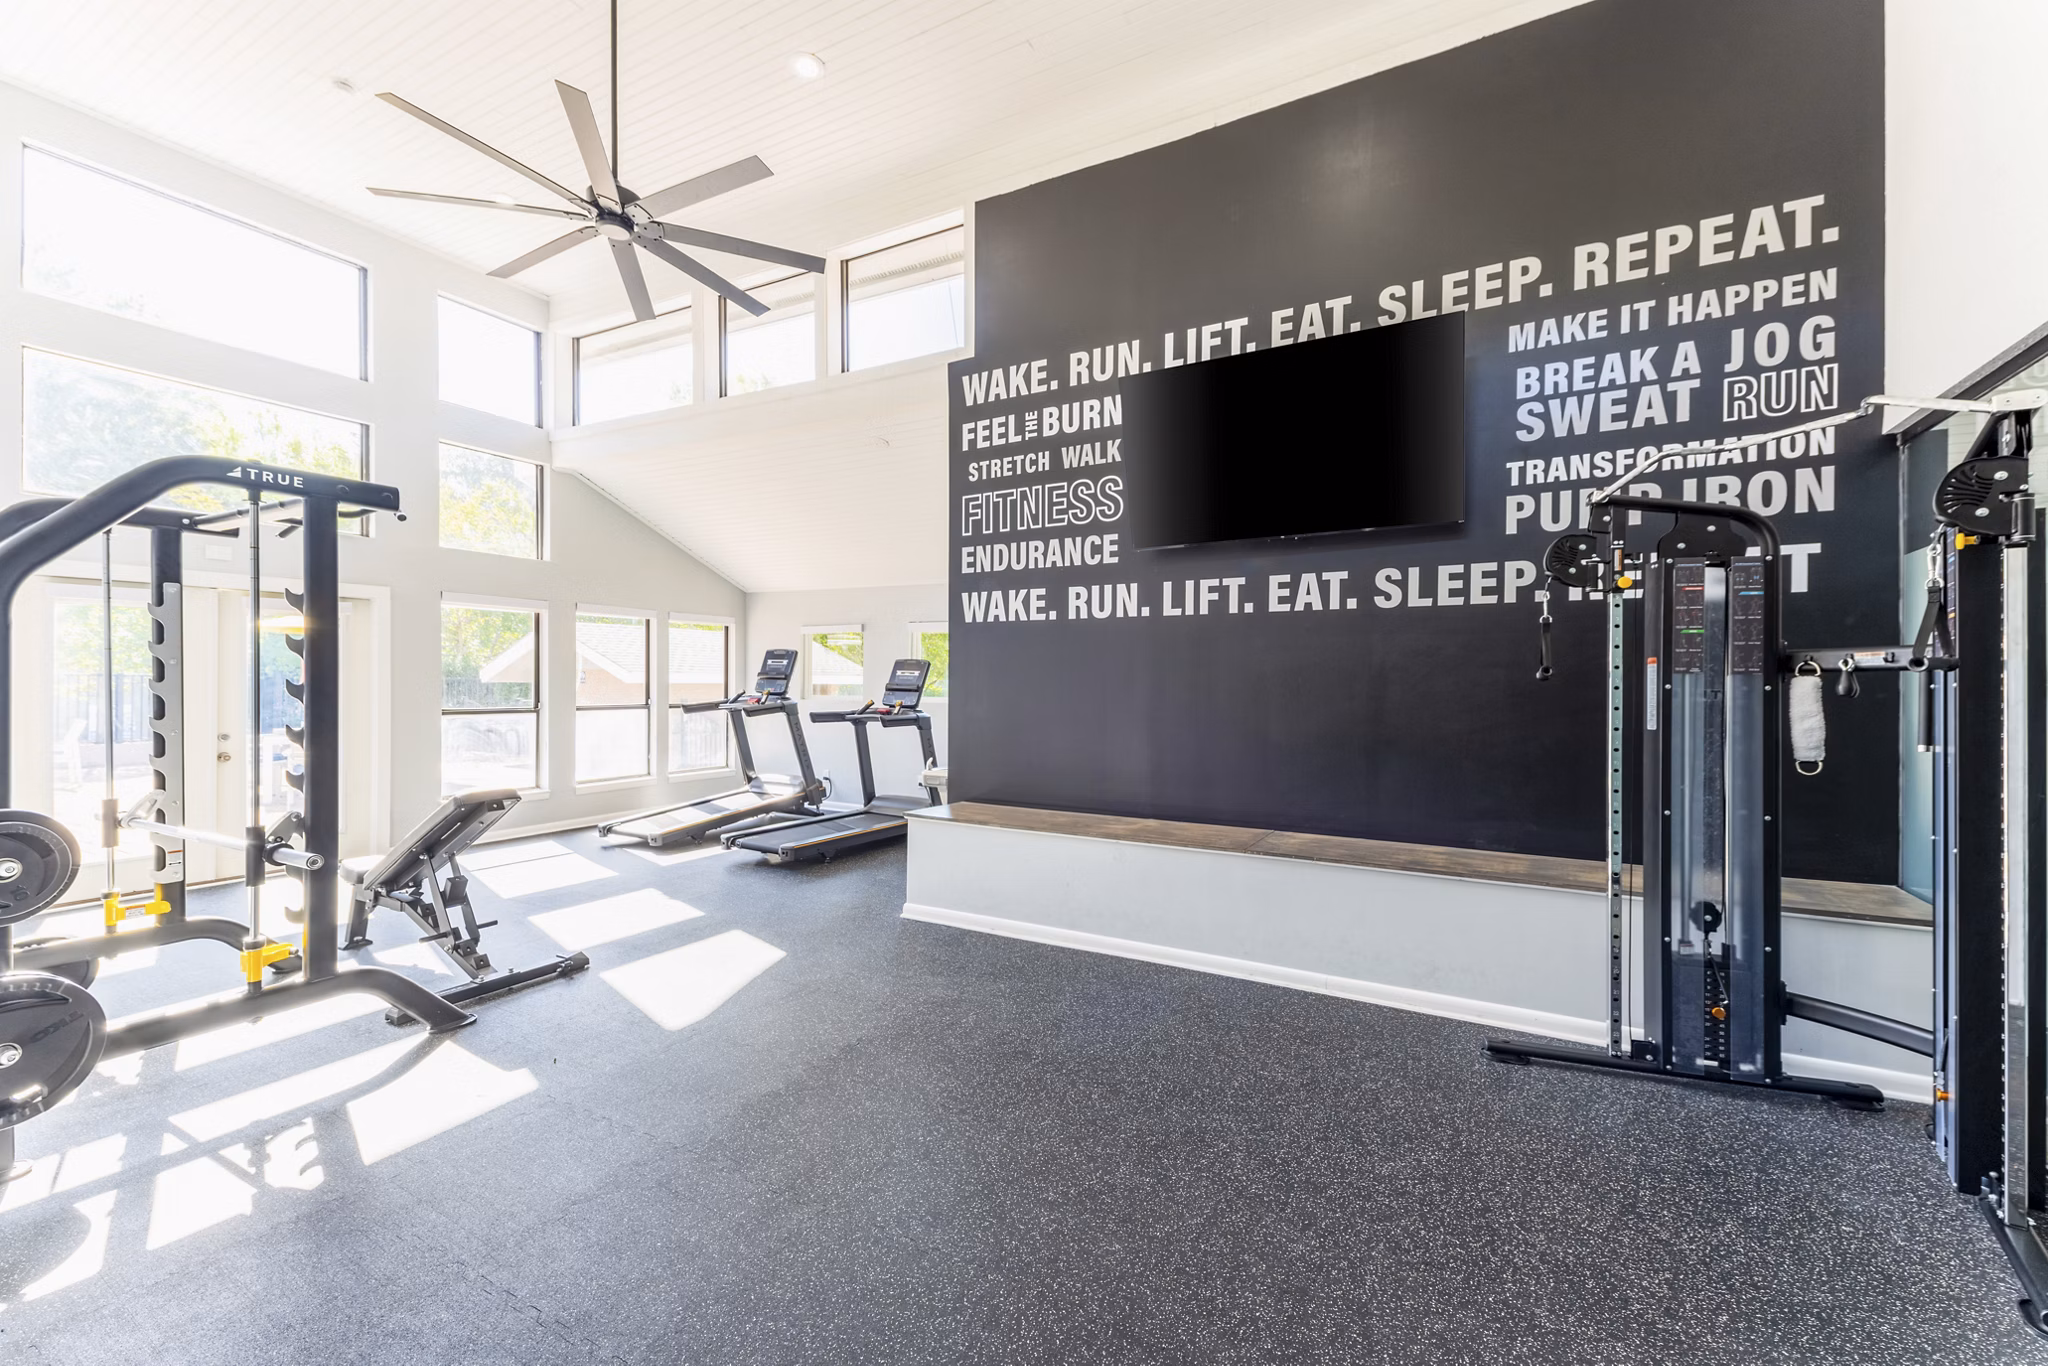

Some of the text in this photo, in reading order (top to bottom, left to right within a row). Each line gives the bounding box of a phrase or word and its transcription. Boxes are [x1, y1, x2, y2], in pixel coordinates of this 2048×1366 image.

[962, 193, 1840, 407] WAKE. RUN. LIFT. EAT. SLEEP. REPEAT.
[1508, 267, 1838, 354] MAKE IT HAPPEN
[1515, 340, 1702, 400] BREAK A
[1723, 314, 1837, 373] JOG
[962, 393, 1122, 451] FEEL THE BURN
[1515, 378, 1701, 442] SWEAT
[1722, 362, 1839, 422] RUN
[246, 468, 304, 489] TRUE
[968, 438, 1122, 482] STRETCH WALK
[1506, 425, 1836, 487] TRANSFORMATION
[962, 474, 1124, 536] FITNESS
[961, 533, 1119, 574] ENDURANCE
[962, 587, 1058, 624] WAKE.
[1068, 582, 1150, 620] RUN.
[1162, 576, 1255, 617] LIFT.
[1268, 570, 1358, 613] EAT.
[1373, 559, 1551, 609] SLEEP.
